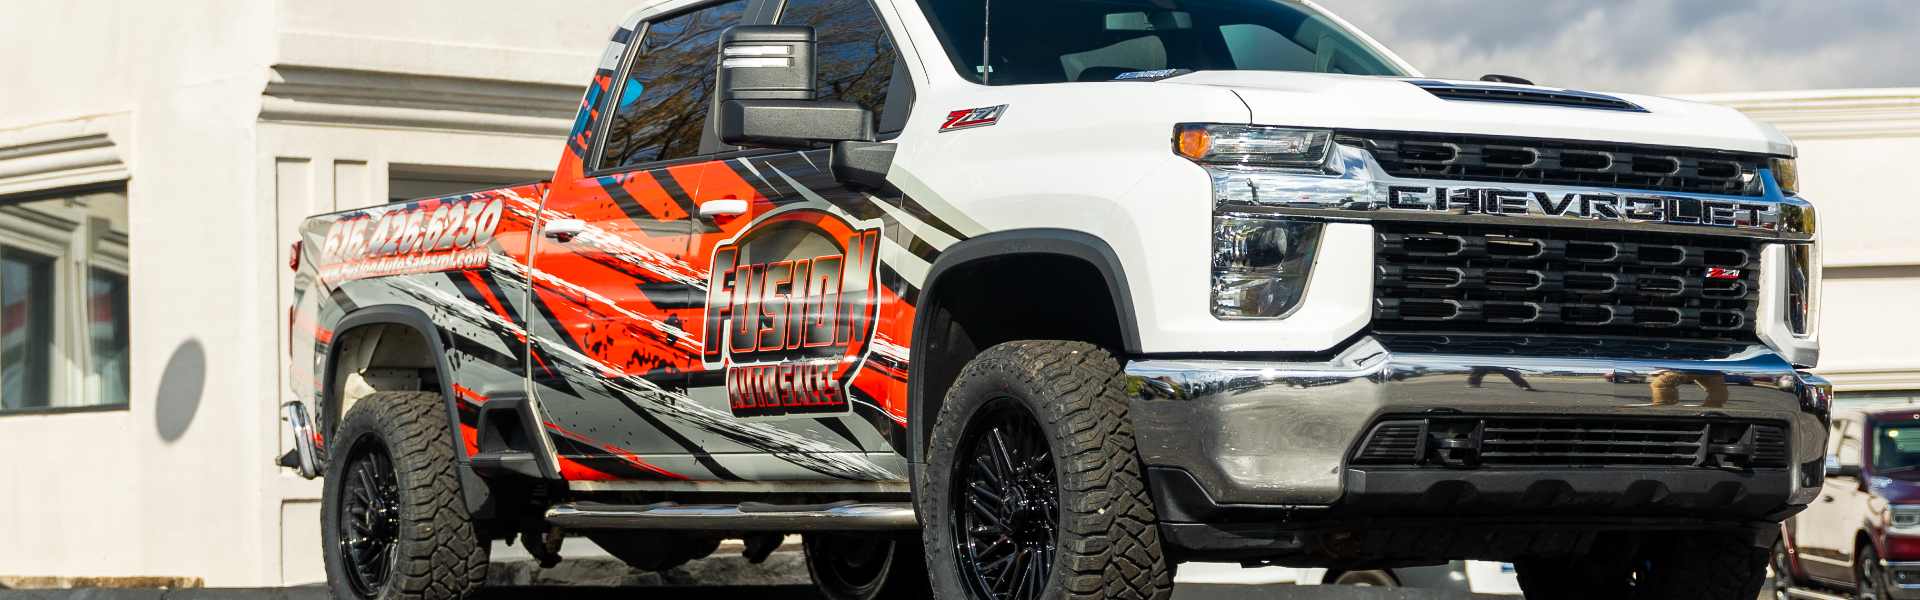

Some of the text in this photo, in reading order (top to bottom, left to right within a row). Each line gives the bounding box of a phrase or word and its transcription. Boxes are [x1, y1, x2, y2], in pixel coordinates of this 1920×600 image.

[321, 199, 503, 266] 616.426.6230
[1387, 185, 1772, 228] CHEVROLET
[705, 231, 878, 355] FUSION
[729, 363, 843, 409] AUTO SALES
